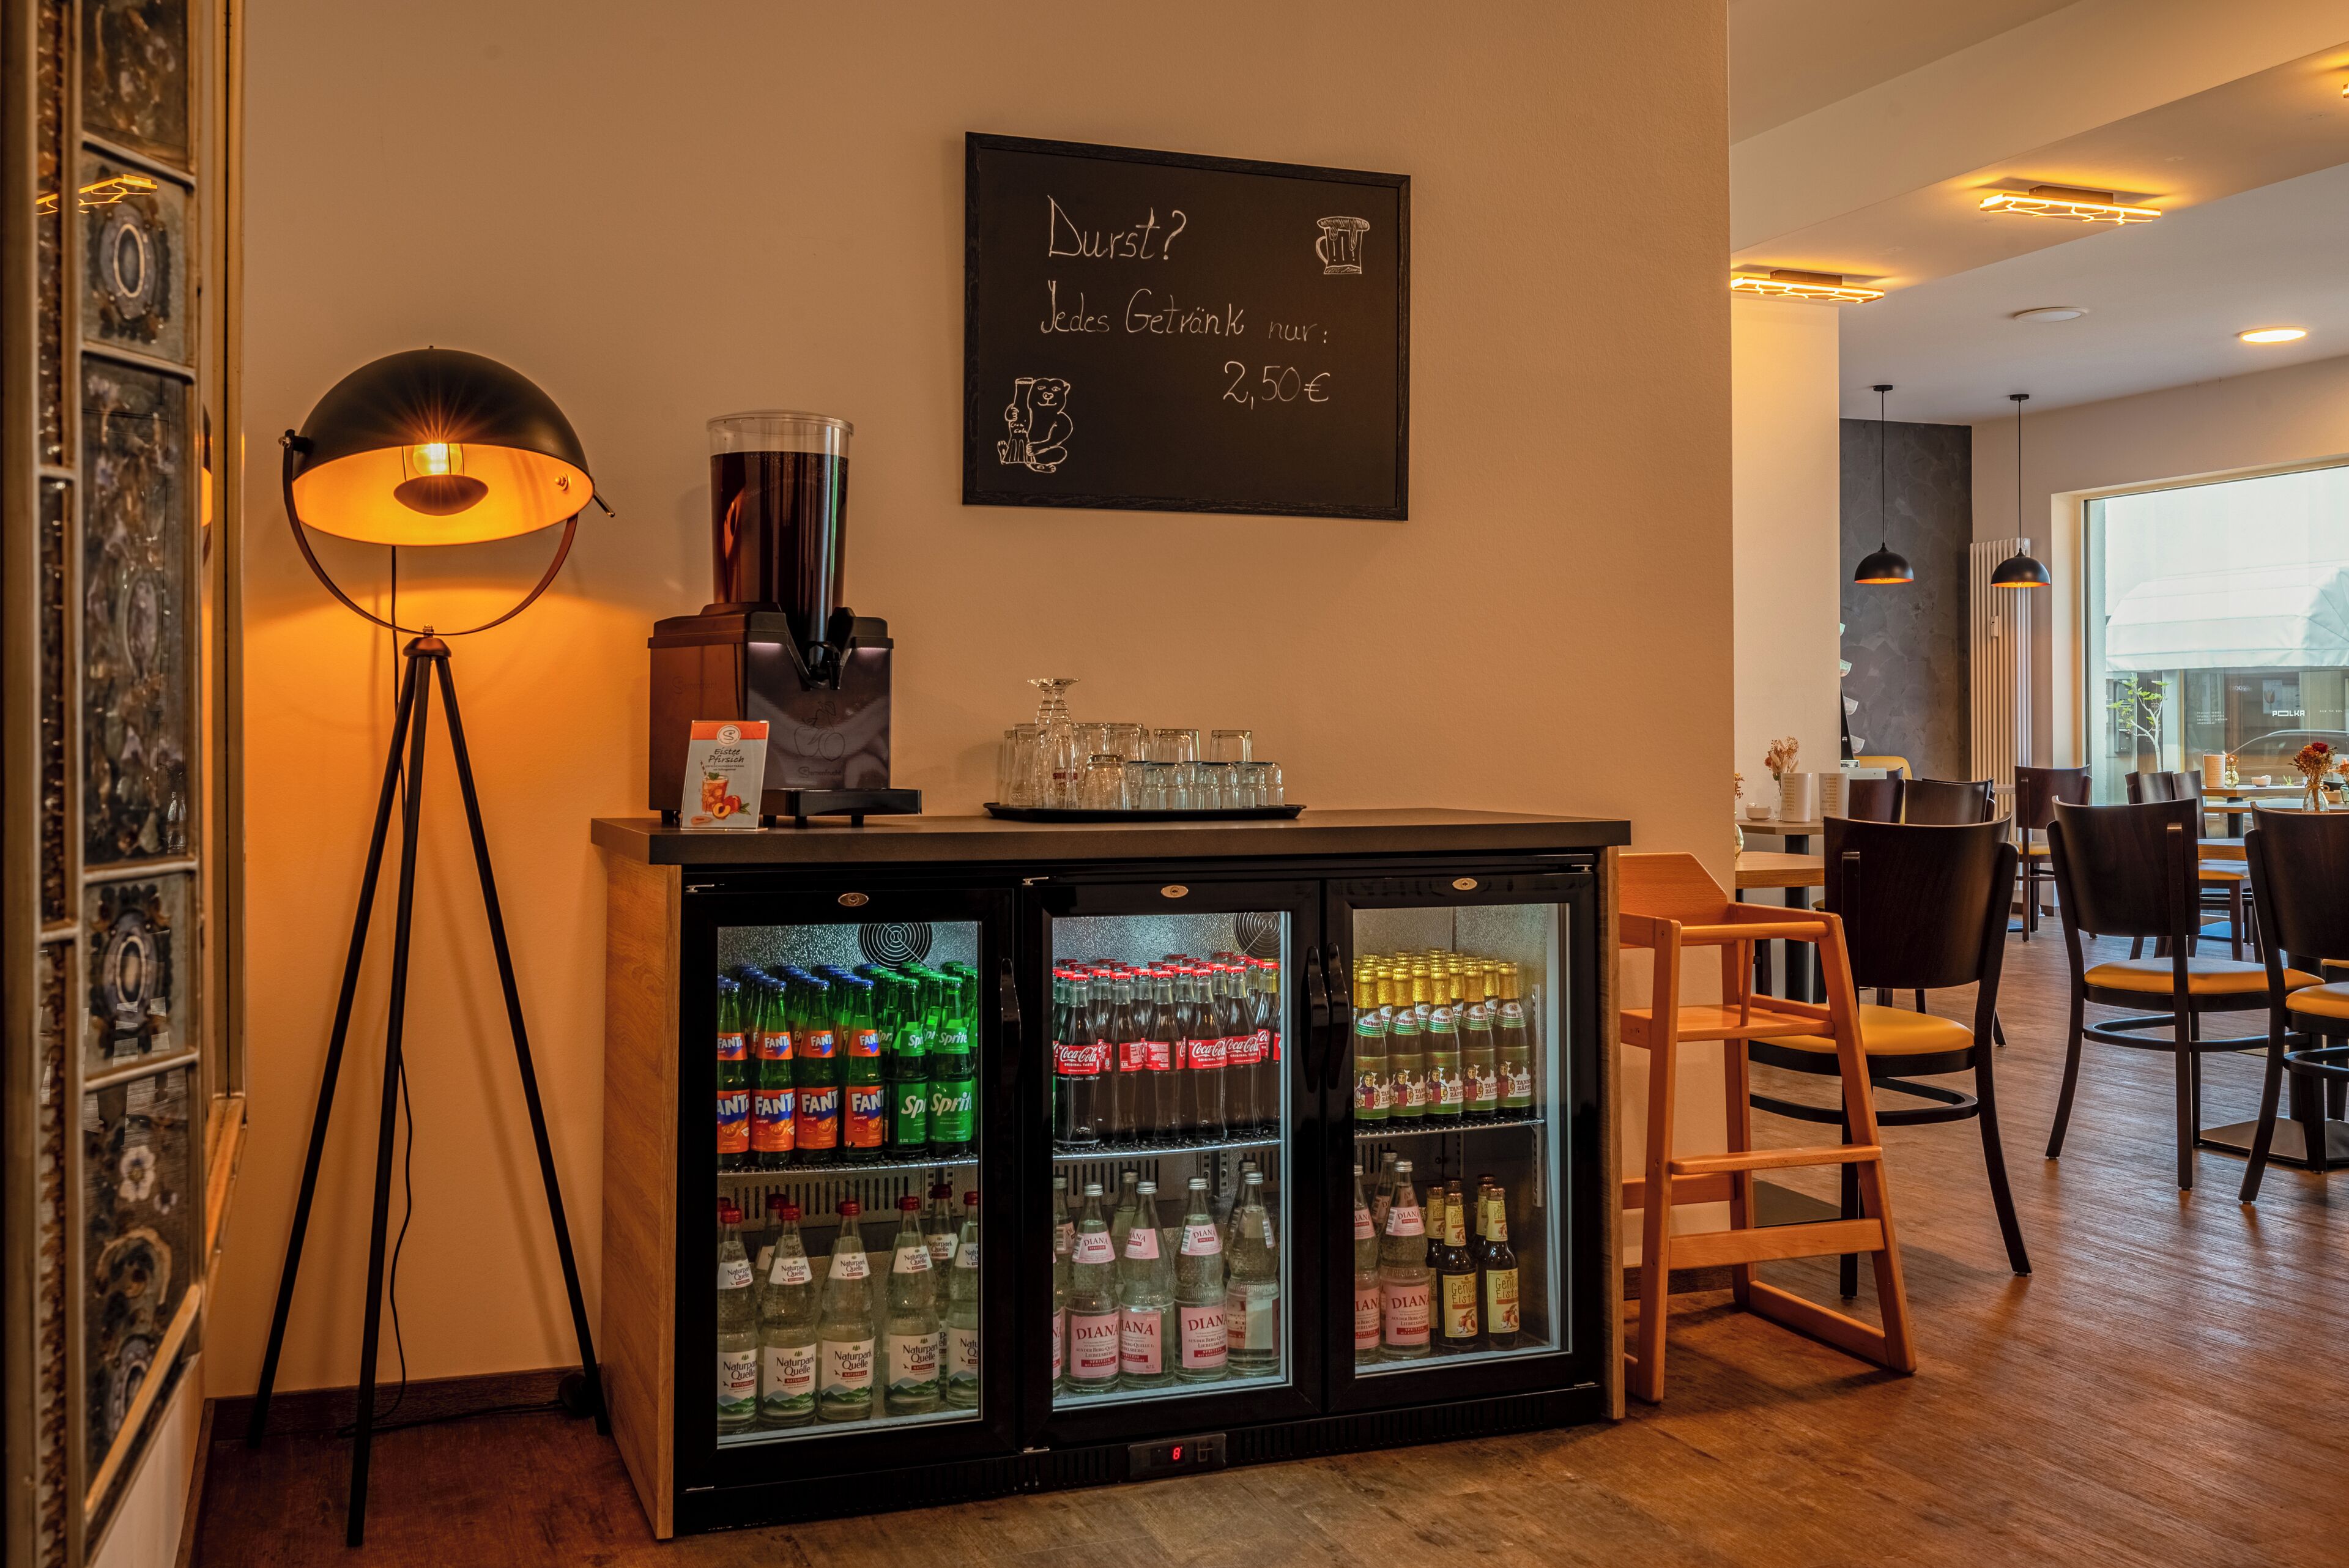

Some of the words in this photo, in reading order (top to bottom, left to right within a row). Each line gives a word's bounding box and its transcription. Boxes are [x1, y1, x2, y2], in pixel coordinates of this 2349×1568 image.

[1047, 195, 1187, 261] Durst?
[1040, 280, 1111, 335] Jedes
[1126, 288, 1245, 338] Getränk
[1223, 360, 1330, 411] 2,50€
[714, 746, 741, 755] Eistee
[708, 754, 744, 765] Pfirsich
[939, 1031, 968, 1046] Sprite
[1060, 1046, 1097, 1063] Coca-Cola
[801, 1090, 839, 1113] FANT
[852, 1089, 884, 1112] FANT
[930, 1091, 971, 1117] Sprit
[1083, 1237, 1108, 1246] DIANA
[1451, 1282, 1475, 1295] Genus
[1495, 1277, 1518, 1290] Genus
[1452, 1294, 1474, 1304] Eiste
[1496, 1289, 1518, 1299] Eiste
[1120, 1320, 1154, 1336] IANA
[776, 1353, 815, 1367] Naturpark
[834, 1348, 872, 1362] Naturpark
[910, 1353, 935, 1364] Quelle
[723, 1358, 757, 1371] Naturpar
[784, 1365, 811, 1377] Quelle
[842, 1359, 868, 1370] Quelle
[731, 1369, 755, 1381] Quelle
